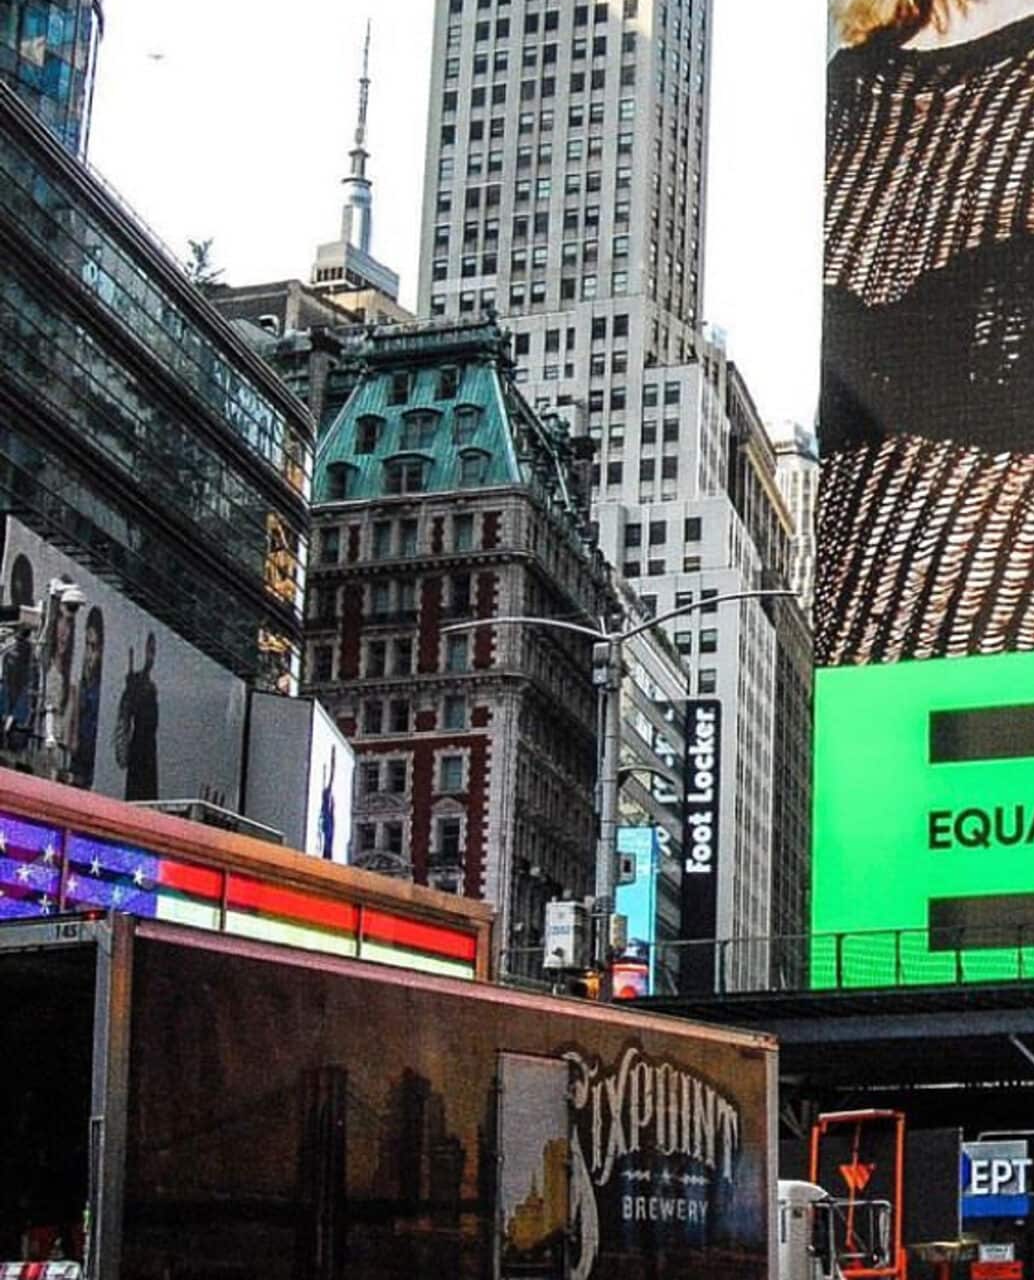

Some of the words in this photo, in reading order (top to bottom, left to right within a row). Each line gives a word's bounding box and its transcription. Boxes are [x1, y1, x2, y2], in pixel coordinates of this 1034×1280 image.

[687, 708, 715, 802] Locker
[686, 812, 713, 873] Foot
[622, 1196, 709, 1223] BREWERY
